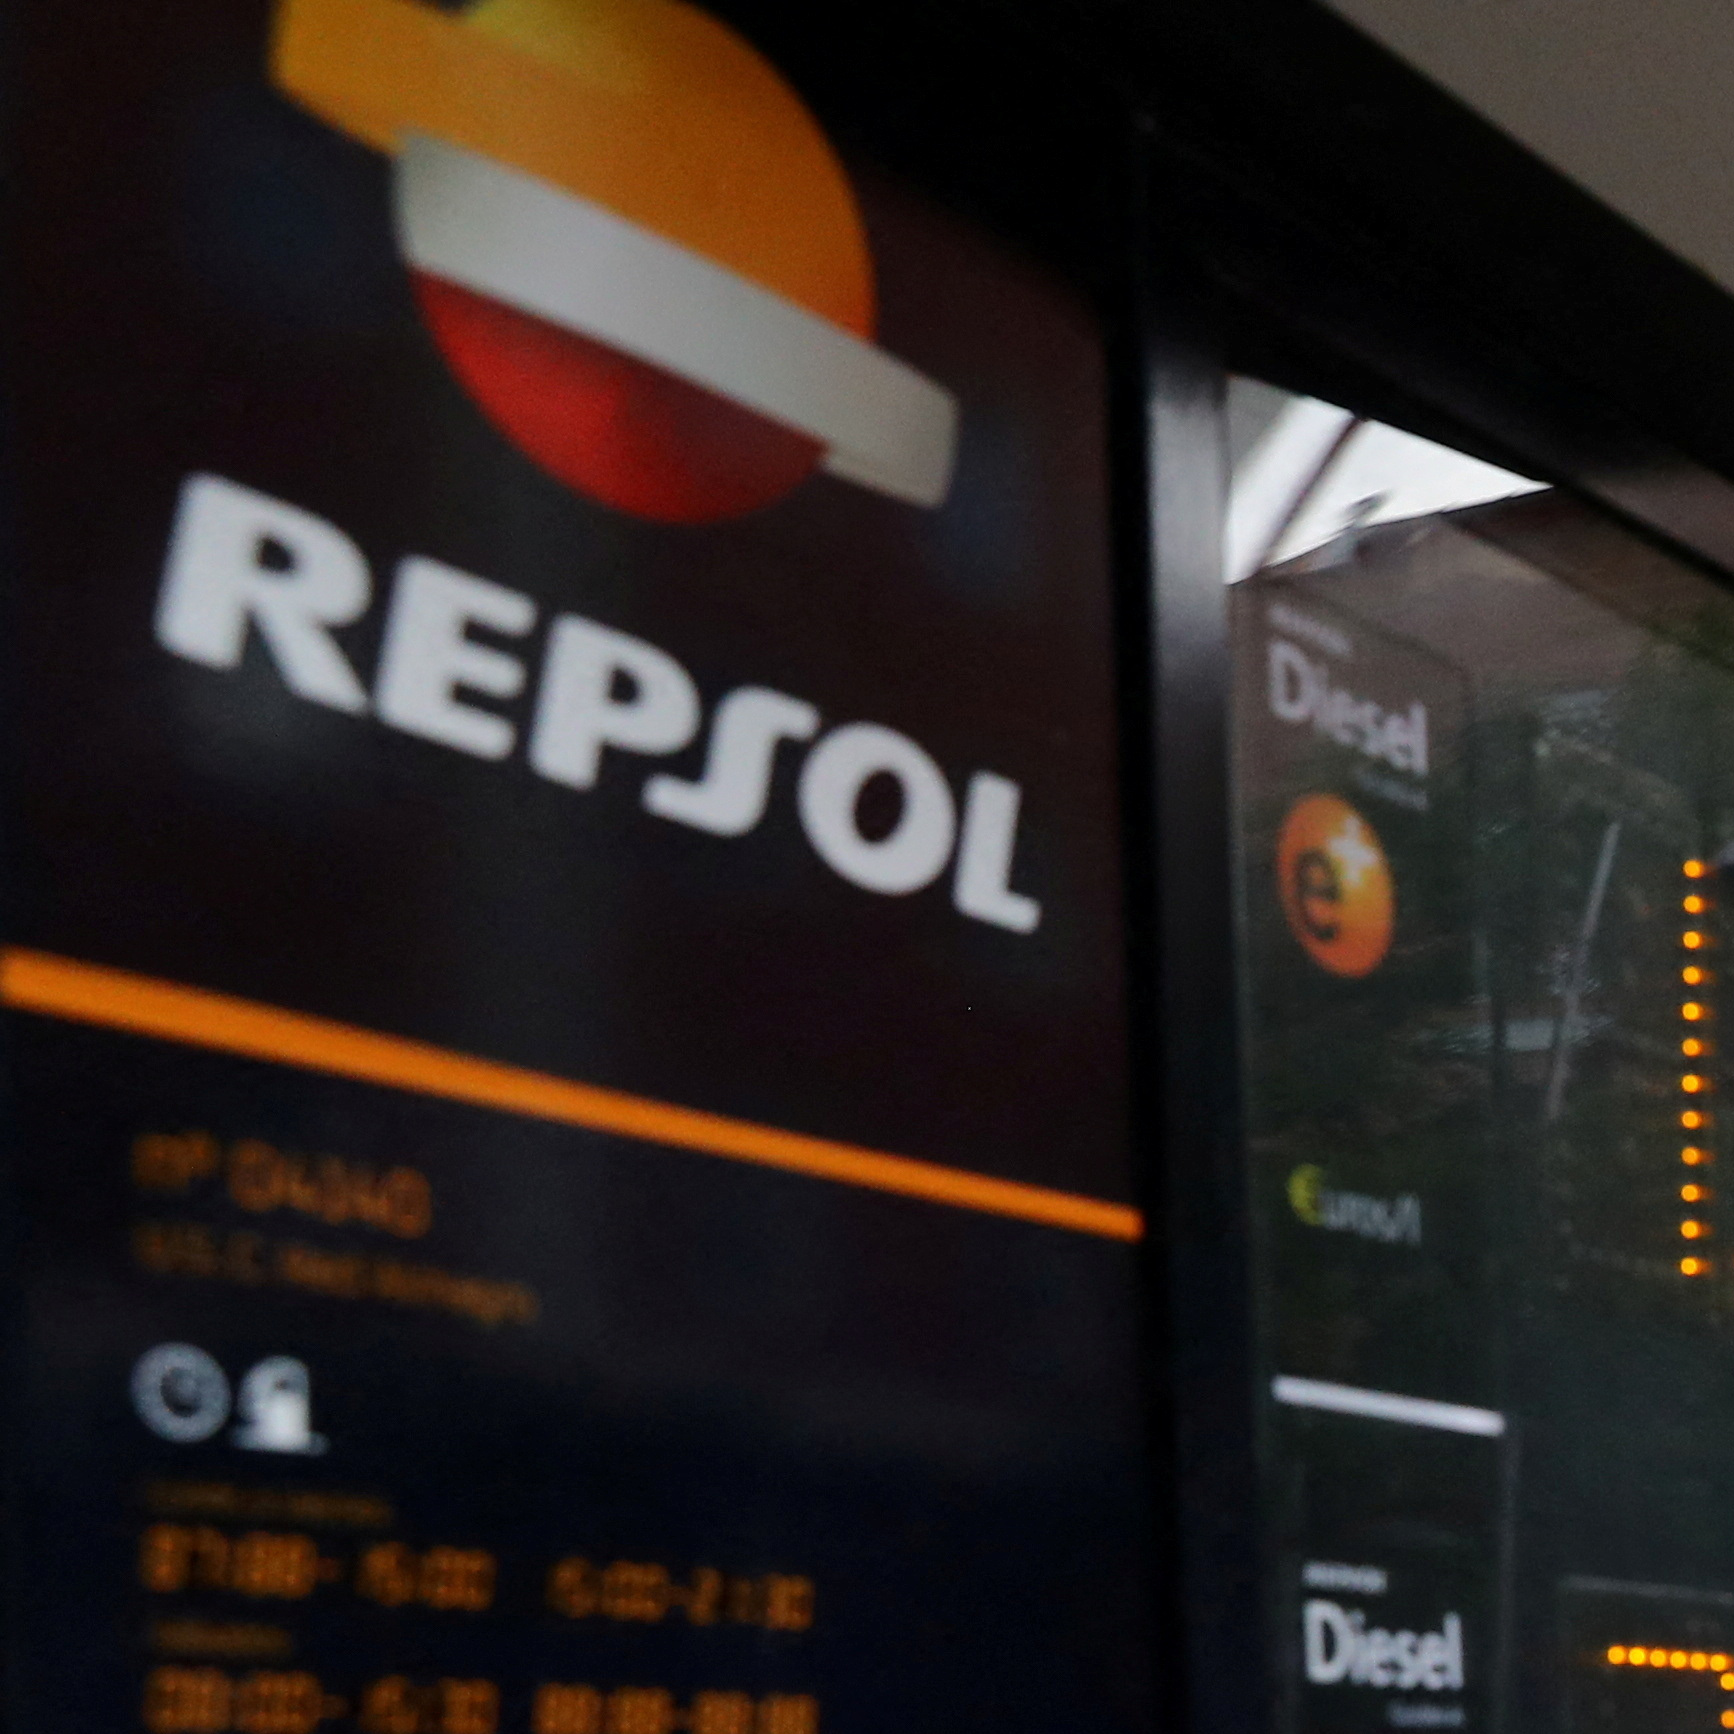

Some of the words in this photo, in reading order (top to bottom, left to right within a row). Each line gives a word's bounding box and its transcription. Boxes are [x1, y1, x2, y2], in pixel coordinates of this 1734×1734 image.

[155, 470, 1042, 935] REPSOL
[1267, 639, 1429, 775] Diesel
[1302, 1599, 1464, 1691] Diesel
